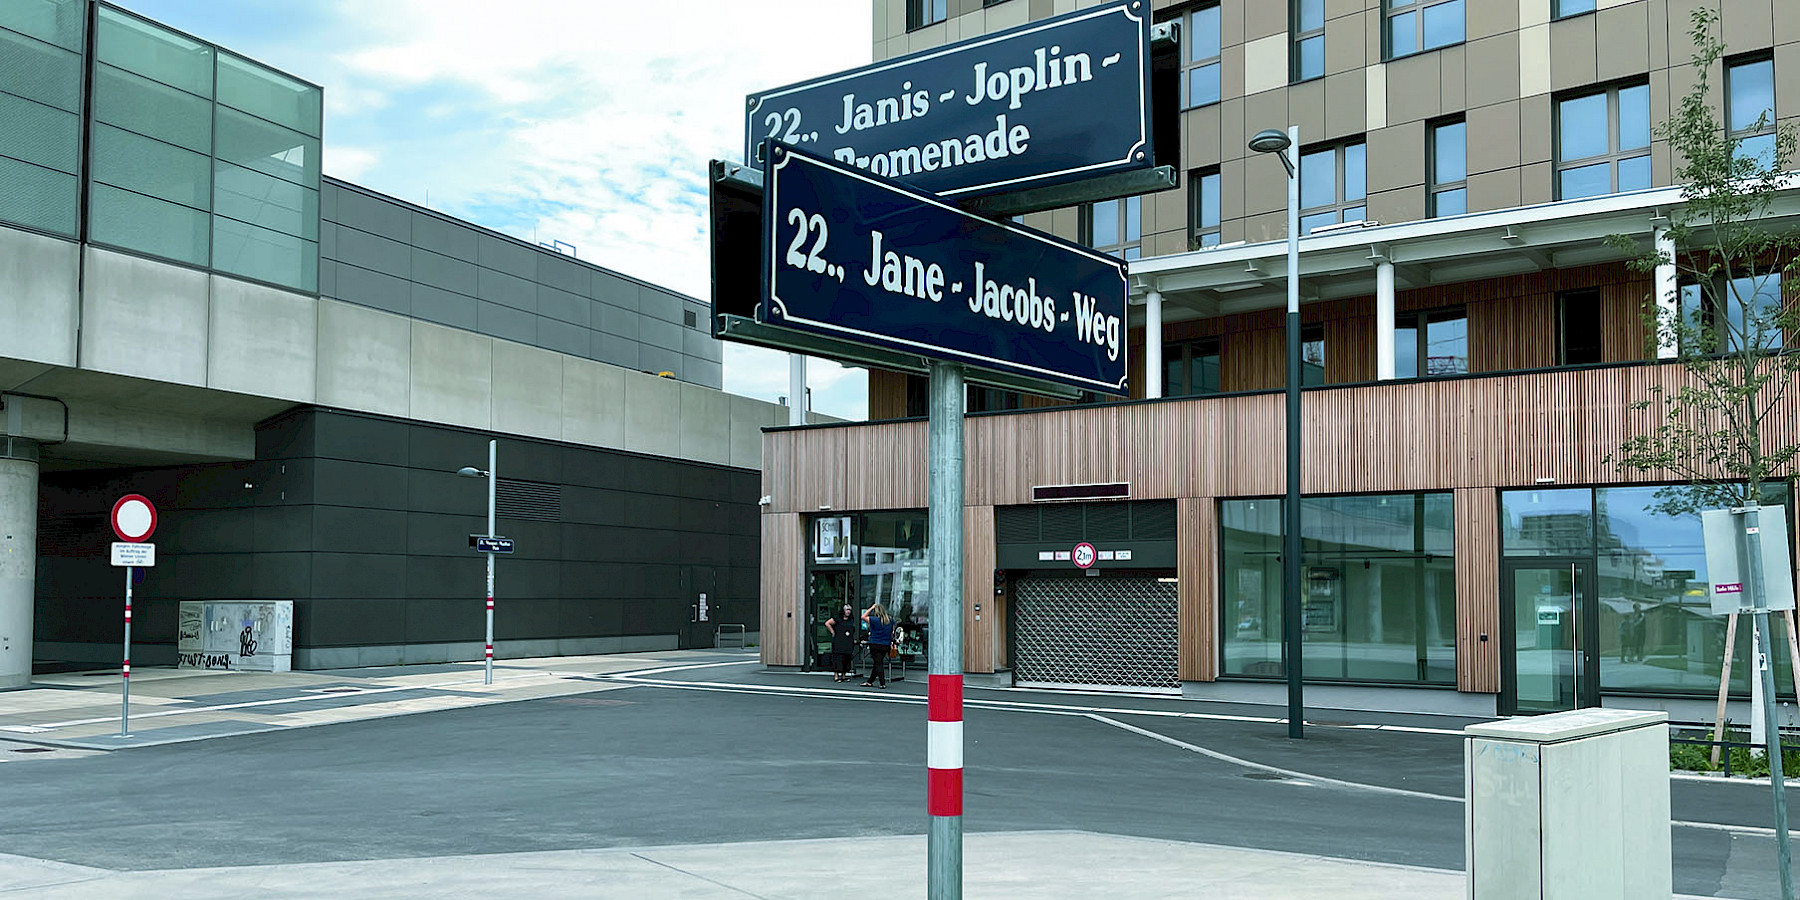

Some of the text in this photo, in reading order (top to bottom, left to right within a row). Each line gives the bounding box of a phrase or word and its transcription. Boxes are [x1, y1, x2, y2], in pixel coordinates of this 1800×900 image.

[763, 107, 819, 144] 22.,
[834, 81, 930, 135] Janis
[965, 44, 1093, 109] Joplin
[786, 207, 844, 283] 22.,
[862, 230, 945, 303] Jane
[968, 261, 1056, 333] Jacobs
[1072, 291, 1121, 361] Weg
